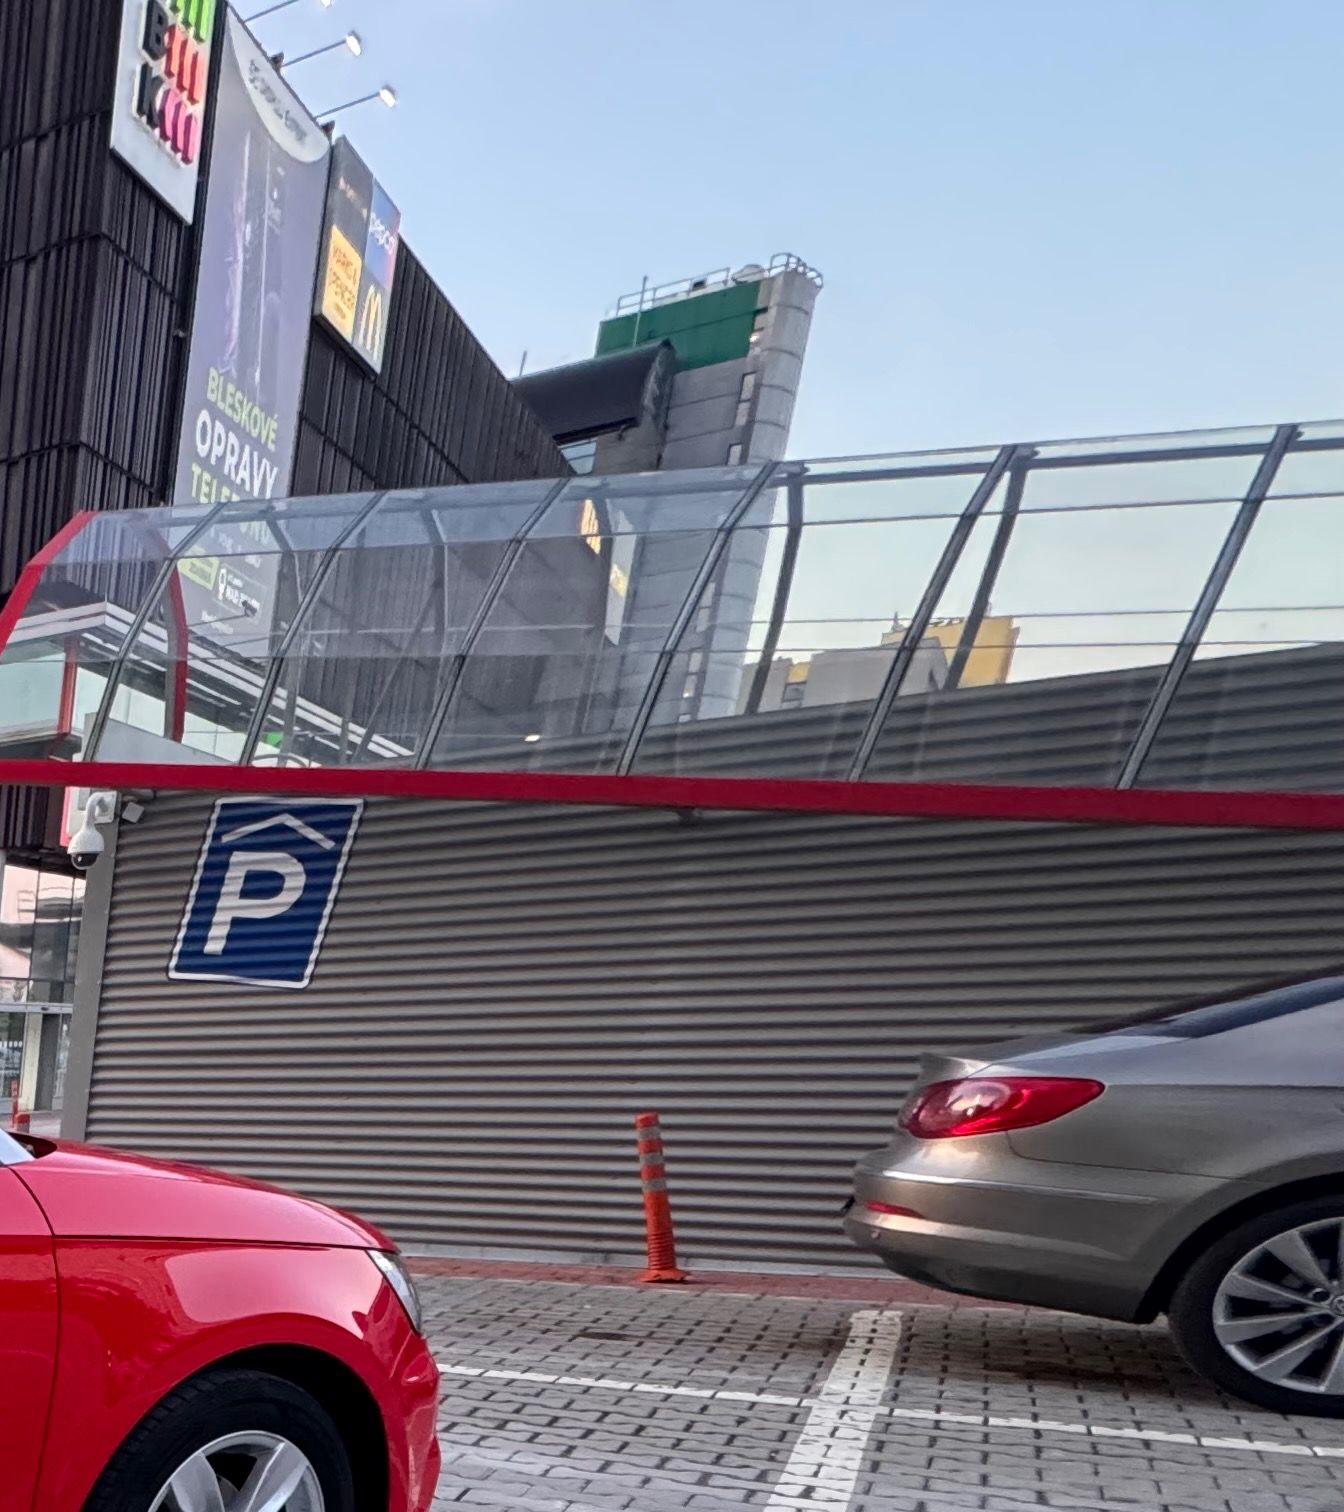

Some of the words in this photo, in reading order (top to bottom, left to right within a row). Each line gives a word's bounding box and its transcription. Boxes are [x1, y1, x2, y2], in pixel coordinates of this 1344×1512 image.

[196, 409, 279, 500] OPRAVY
[207, 366, 279, 452] BLESKOVÉ
[203, 851, 307, 956] P
